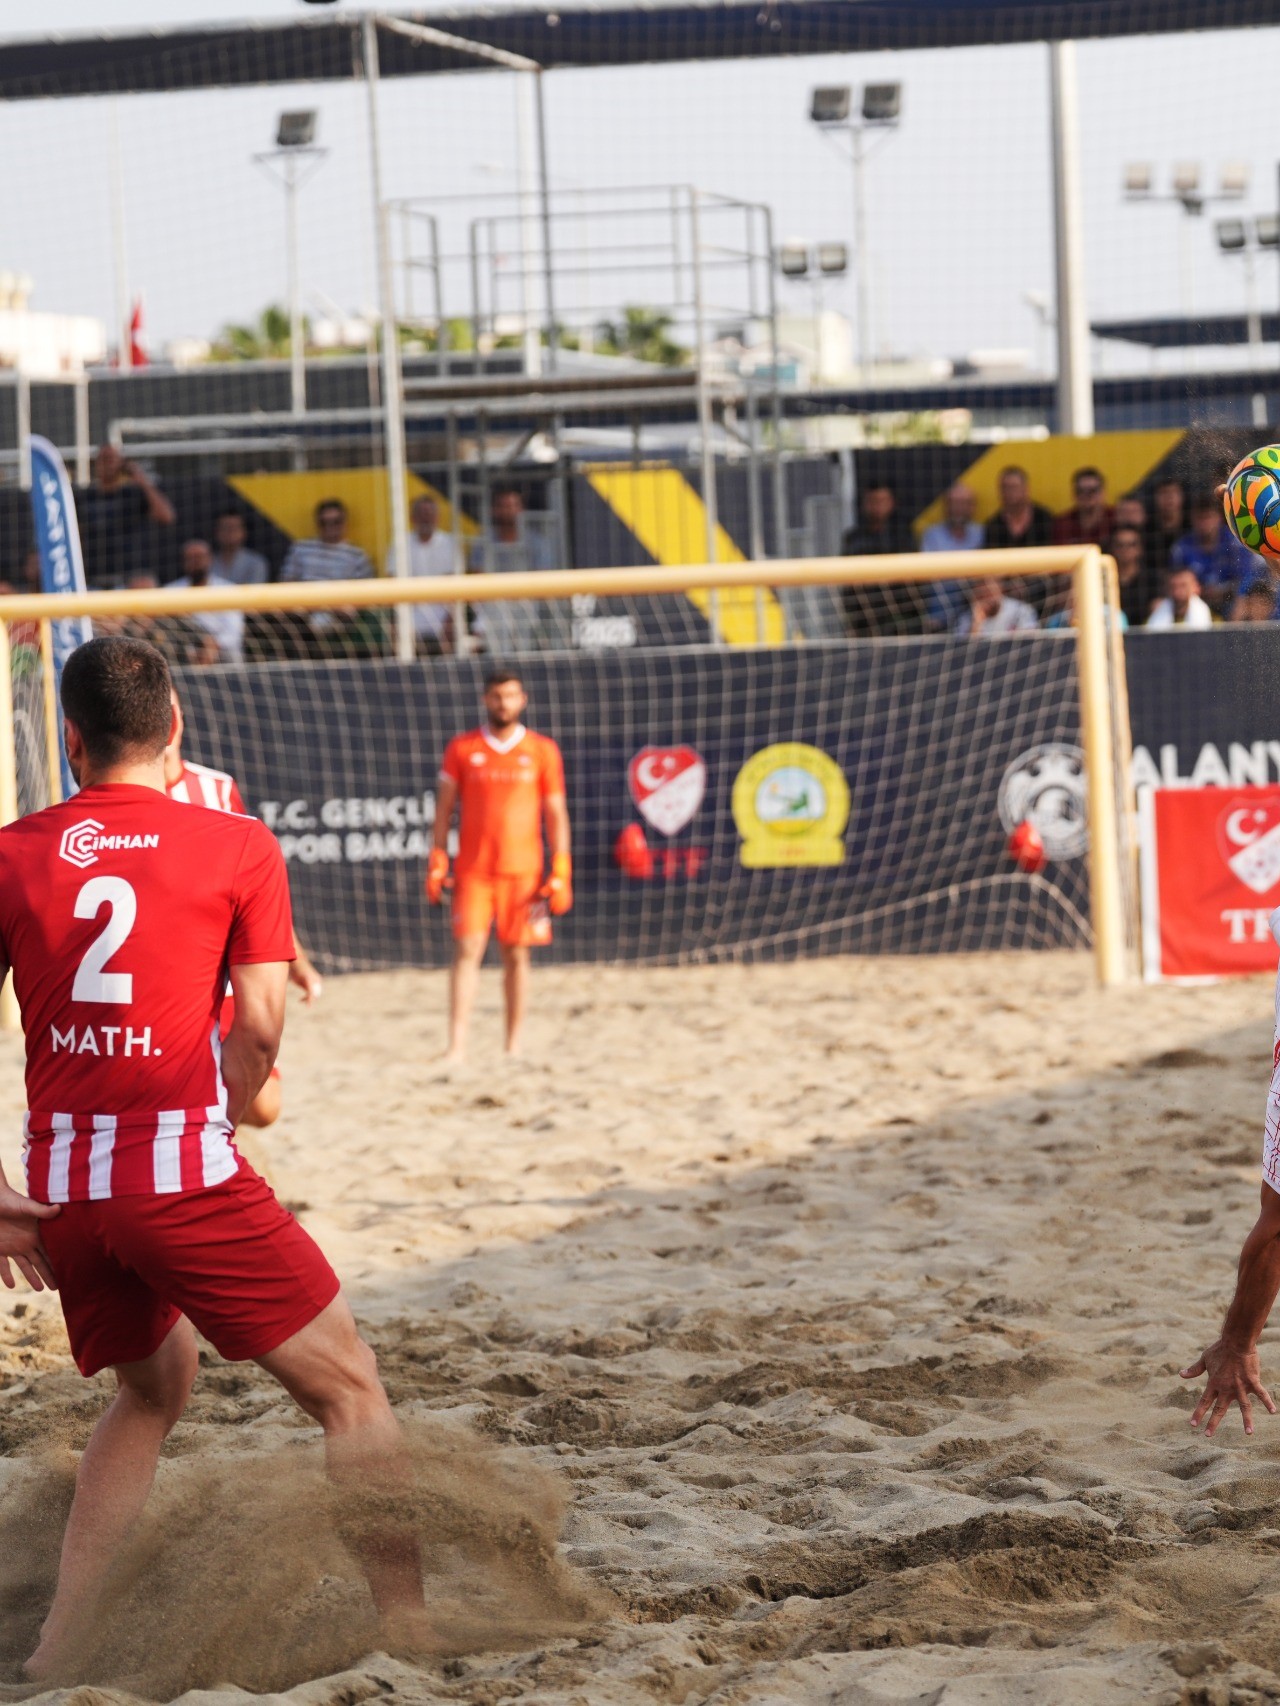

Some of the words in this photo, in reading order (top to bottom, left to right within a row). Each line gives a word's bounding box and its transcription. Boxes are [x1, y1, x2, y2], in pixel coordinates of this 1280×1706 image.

[71, 875, 137, 1005] 2
[1220, 908, 1275, 944] TF
[51, 1022, 163, 1058] MATH.
